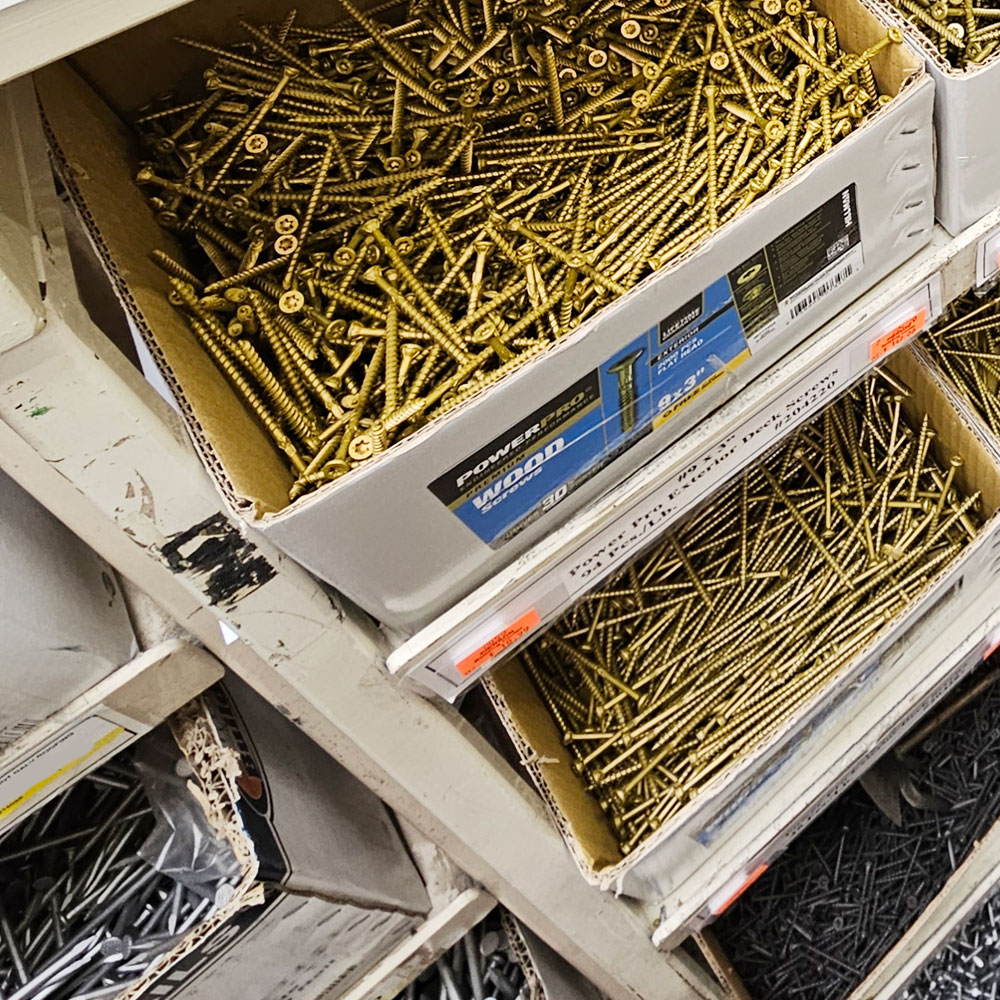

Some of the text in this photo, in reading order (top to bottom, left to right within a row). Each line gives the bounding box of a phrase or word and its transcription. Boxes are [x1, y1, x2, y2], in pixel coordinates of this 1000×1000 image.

[658, 327, 699, 360] EXTERIOR
[658, 339, 703, 375] FLAT HEAD
[774, 380, 836, 431] #204220
[466, 453, 526, 498] PREMIUM
[472, 438, 564, 510] WOOD
[481, 466, 543, 514] Screws
[569, 369, 839, 576] Power Pro Exterior Deck Screws
[677, 465, 697, 482] #9
[581, 505, 677, 578] 94 Pcs./Lb.
